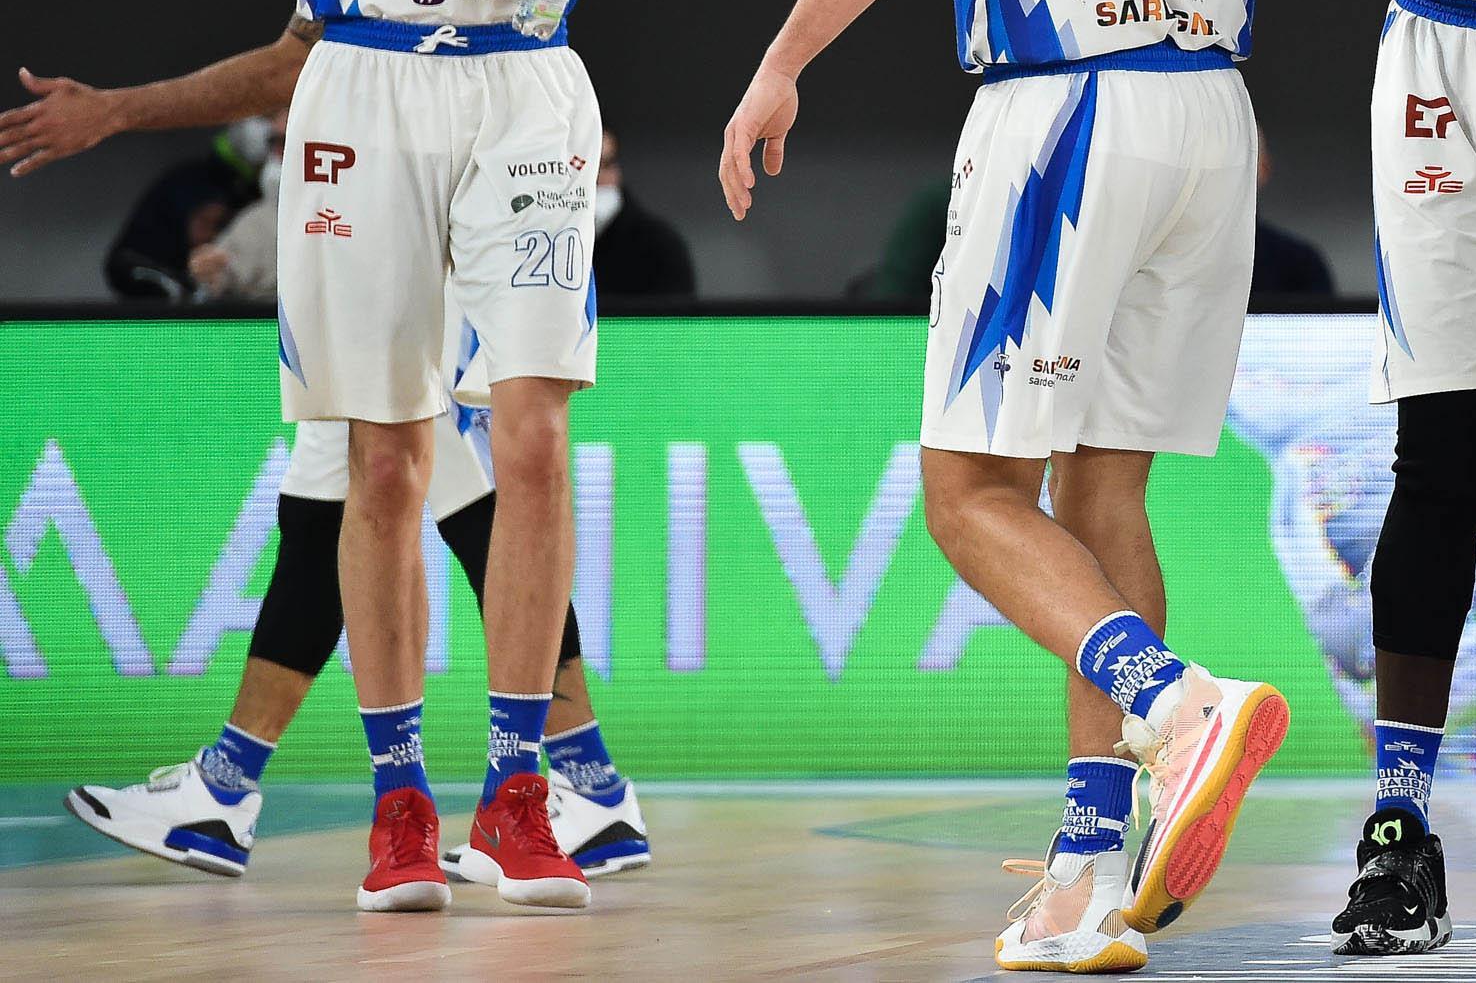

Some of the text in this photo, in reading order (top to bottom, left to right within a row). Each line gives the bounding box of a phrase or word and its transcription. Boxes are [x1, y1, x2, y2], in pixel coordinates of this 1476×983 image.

[303, 141, 356, 185] EP
[511, 226, 584, 291] 20
[1119, 650, 1167, 708] ASSARI
[1124, 658, 1173, 714] ASKETBALL
